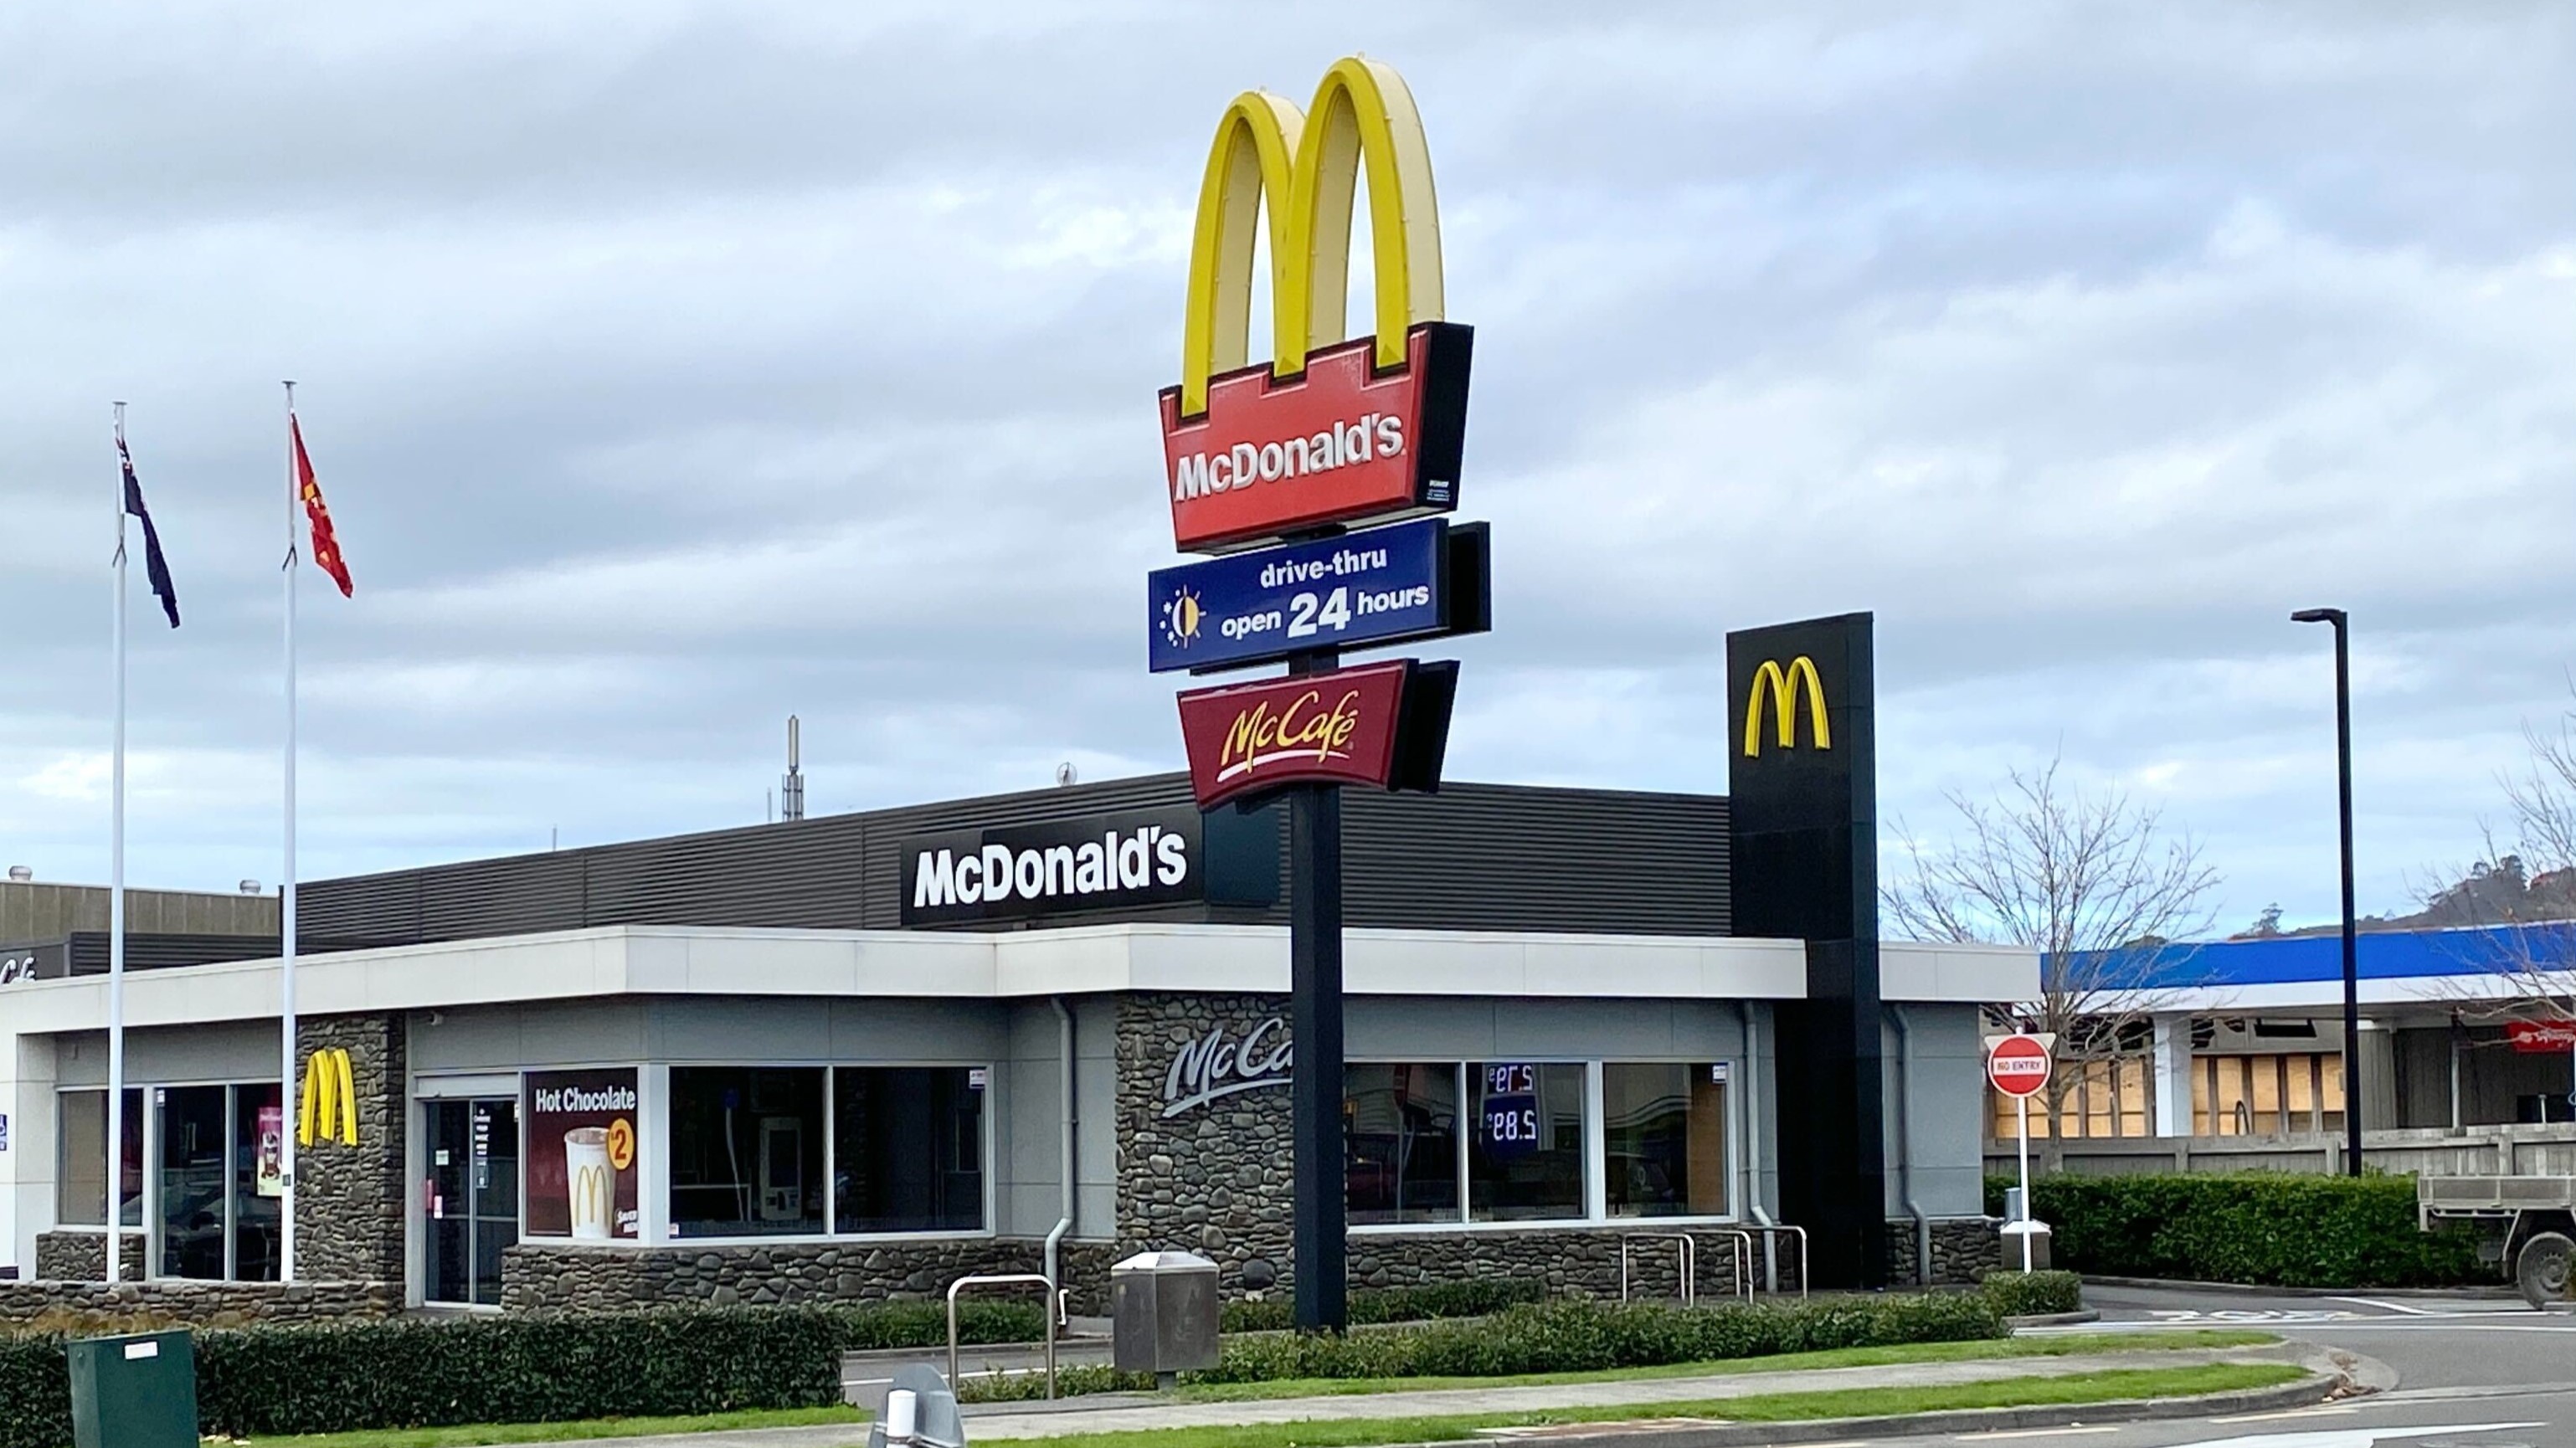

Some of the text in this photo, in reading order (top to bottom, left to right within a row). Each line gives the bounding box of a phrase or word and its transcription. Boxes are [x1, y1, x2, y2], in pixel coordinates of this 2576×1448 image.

[1175, 413, 1404, 501] McDonald's
[1260, 548, 1387, 588] drive-thru
[1221, 585, 1430, 640] open 24 hours
[1221, 689, 1360, 775] McCafé
[913, 825, 1187, 908] McDonald's
[1997, 1060, 2041, 1071] NO ENTRY
[535, 1086, 636, 1113] Hot Chocolate
